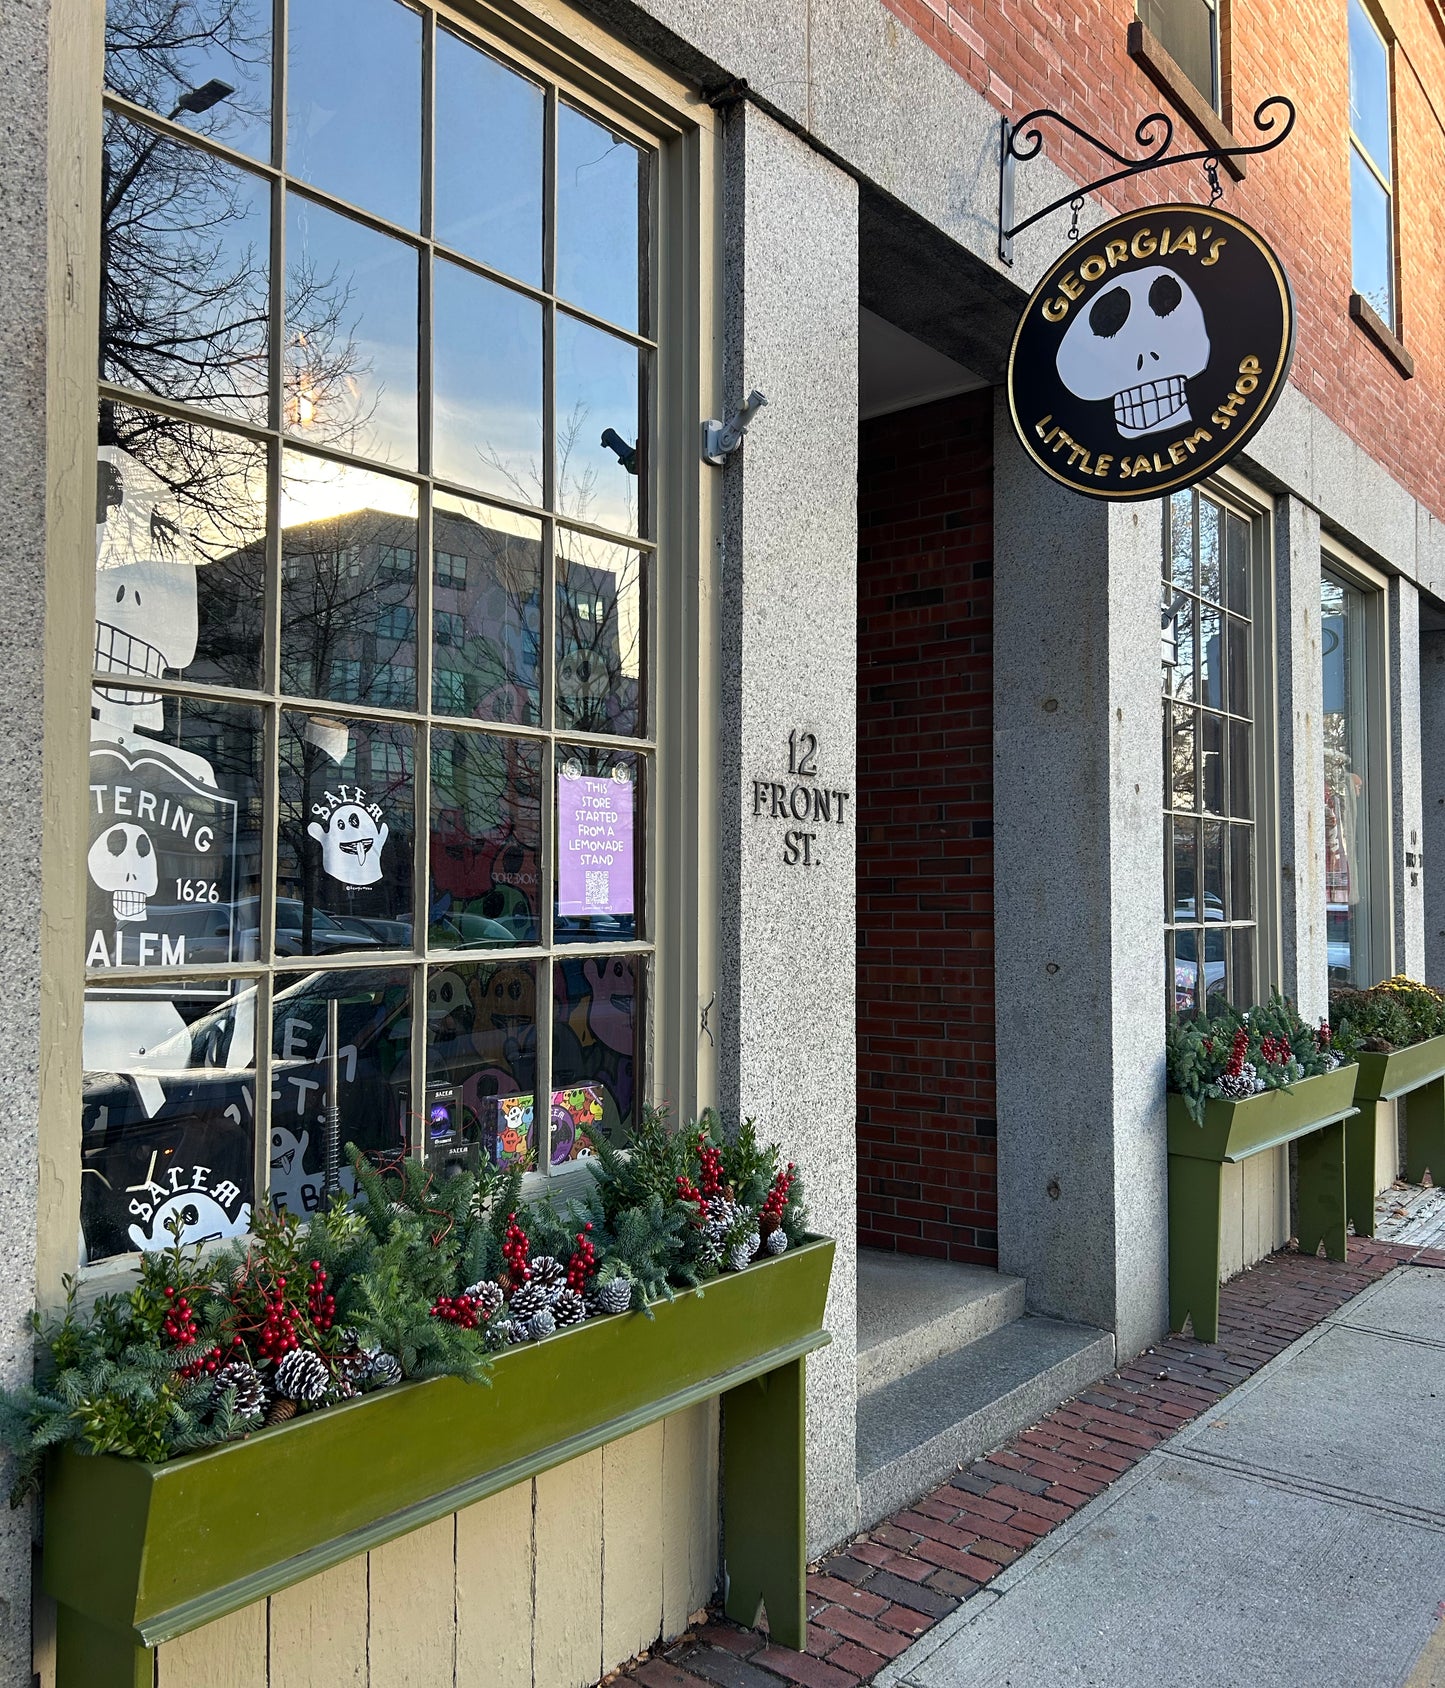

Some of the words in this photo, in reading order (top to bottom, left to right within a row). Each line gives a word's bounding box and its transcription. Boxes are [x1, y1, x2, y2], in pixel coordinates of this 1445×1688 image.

[1041, 225, 1228, 322] GEORGIA'S
[1034, 414, 1114, 477] LITTLE
[1119, 427, 1213, 478] SALEM
[1211, 354, 1263, 430] SHOP
[788, 728, 818, 776] 12
[312, 785, 384, 823] SALEM
[582, 796, 611, 808] STORE
[585, 781, 608, 794] THIS
[752, 781, 850, 824] FRONT
[89, 784, 214, 852] TERING
[575, 810, 618, 823] STARTED
[578, 824, 605, 837] FROM
[607, 827, 615, 836] A
[569, 839, 624, 852] LEMONADE
[580, 854, 614, 866] STAND
[783, 828, 821, 866] ST.
[176, 878, 220, 903] 1626
[129, 1165, 241, 1223] SALEM
